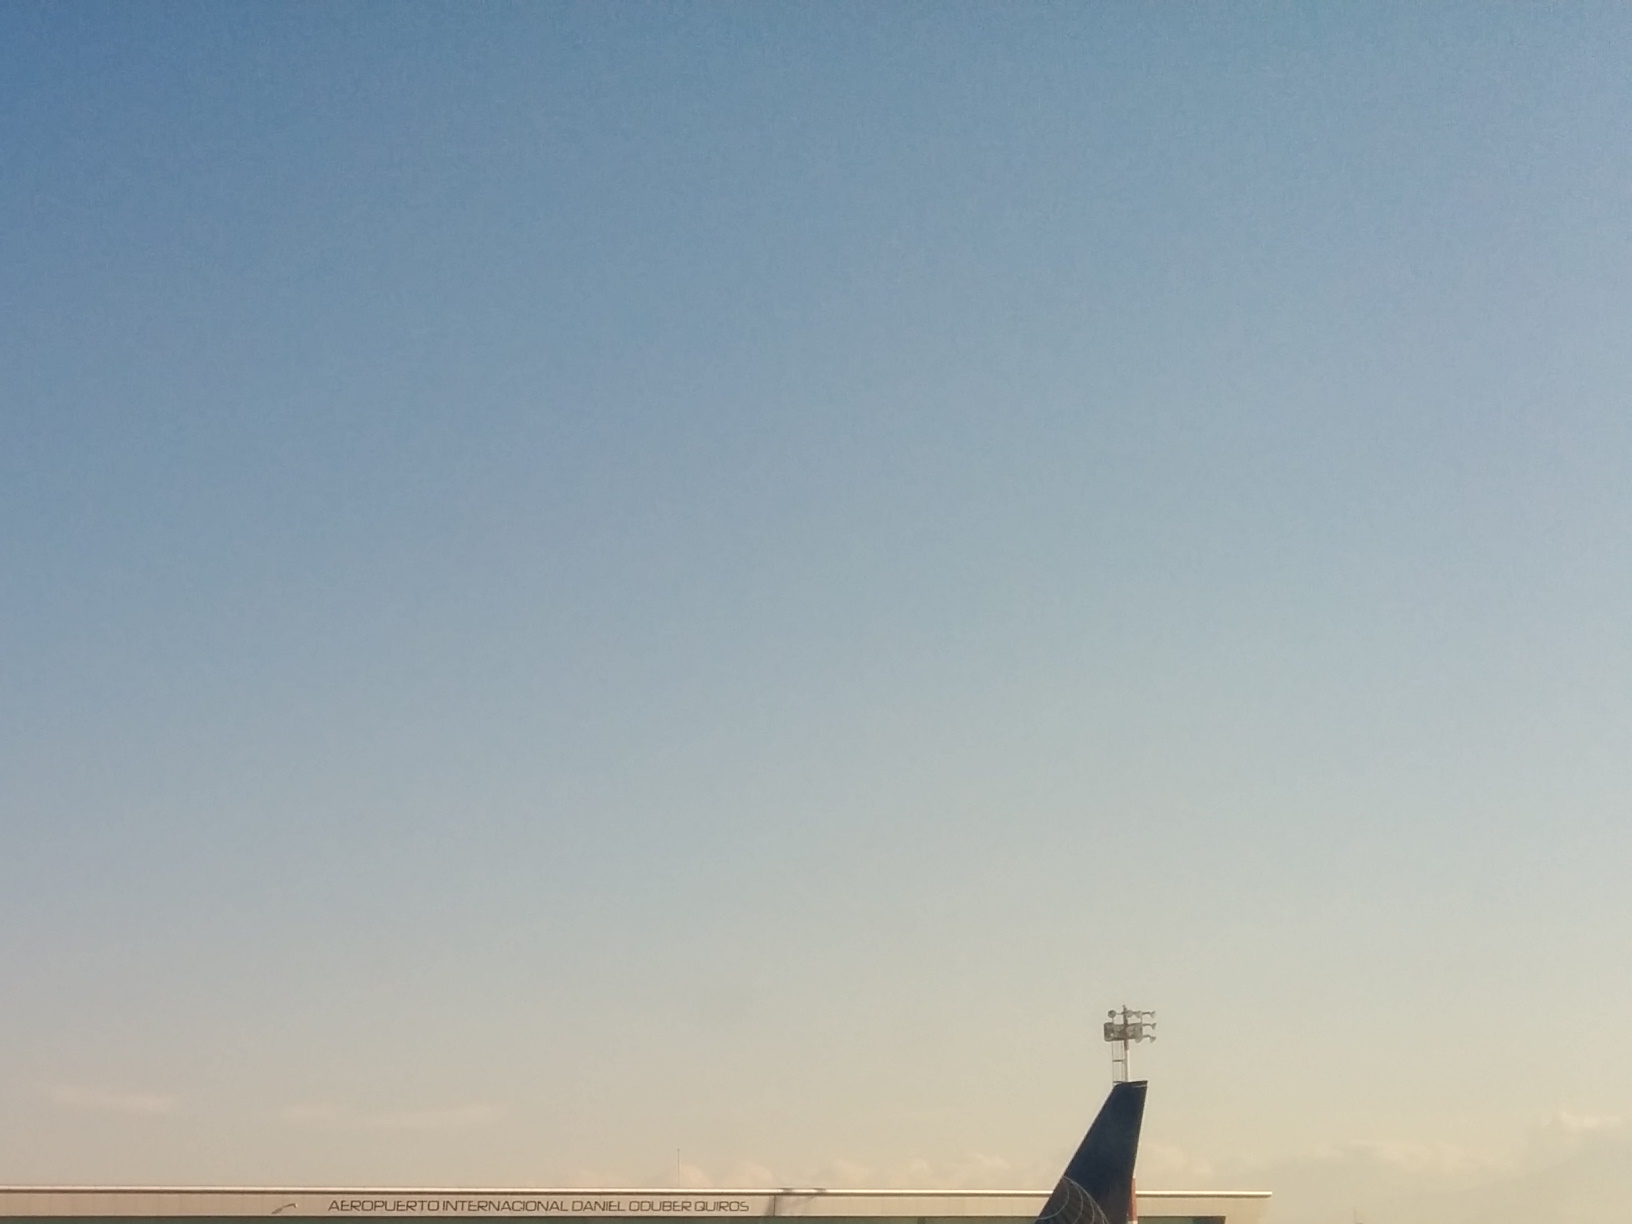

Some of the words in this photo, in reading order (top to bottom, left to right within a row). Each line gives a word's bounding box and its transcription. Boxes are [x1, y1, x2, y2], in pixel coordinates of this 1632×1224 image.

[328, 1200, 440, 1212] AEROPUERTO
[443, 1200, 569, 1212] INTERNACIONAL
[572, 1200, 627, 1212] DANIEL
[629, 1200, 692, 1212] ODUBER
[695, 1200, 749, 1212] QUIROS
